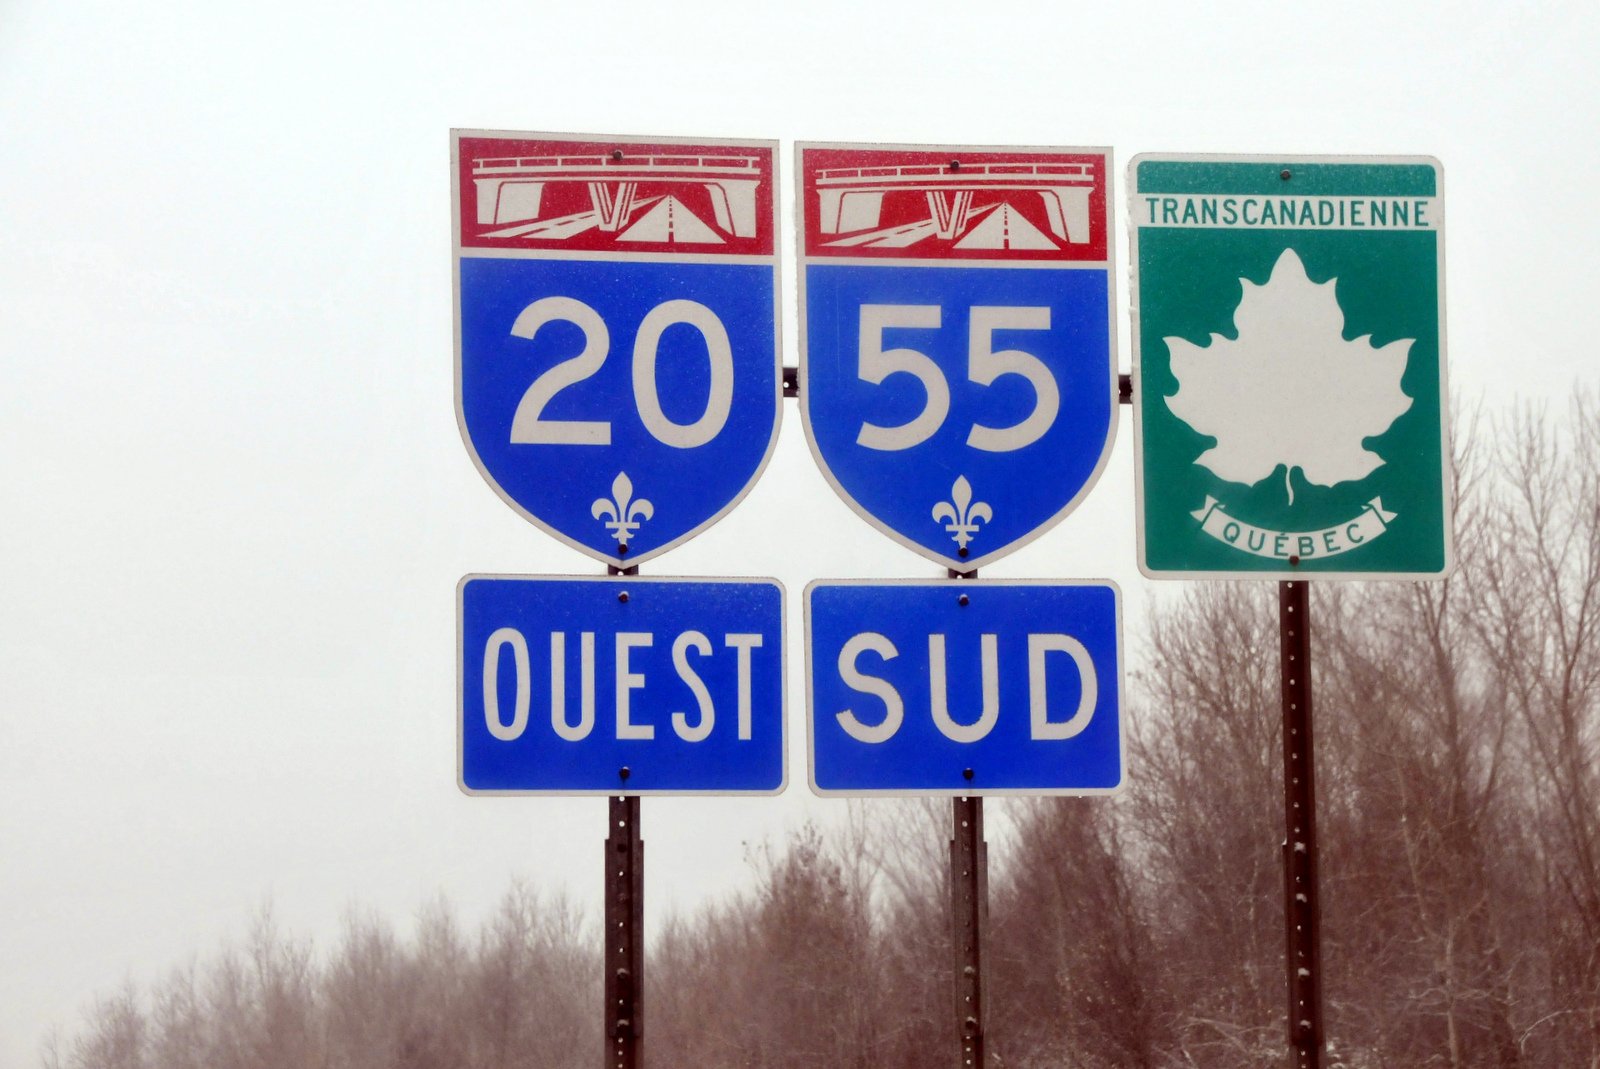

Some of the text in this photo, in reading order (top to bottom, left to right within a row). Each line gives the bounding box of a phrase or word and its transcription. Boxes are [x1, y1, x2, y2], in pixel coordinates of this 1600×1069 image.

[1145, 198, 1429, 227] TRANSCANADIENNE
[509, 295, 735, 449] 20
[855, 303, 1061, 453] 55
[1222, 521, 1365, 557] QUÉBEC
[482, 627, 763, 742] OUEST
[835, 631, 1099, 744] SUD
